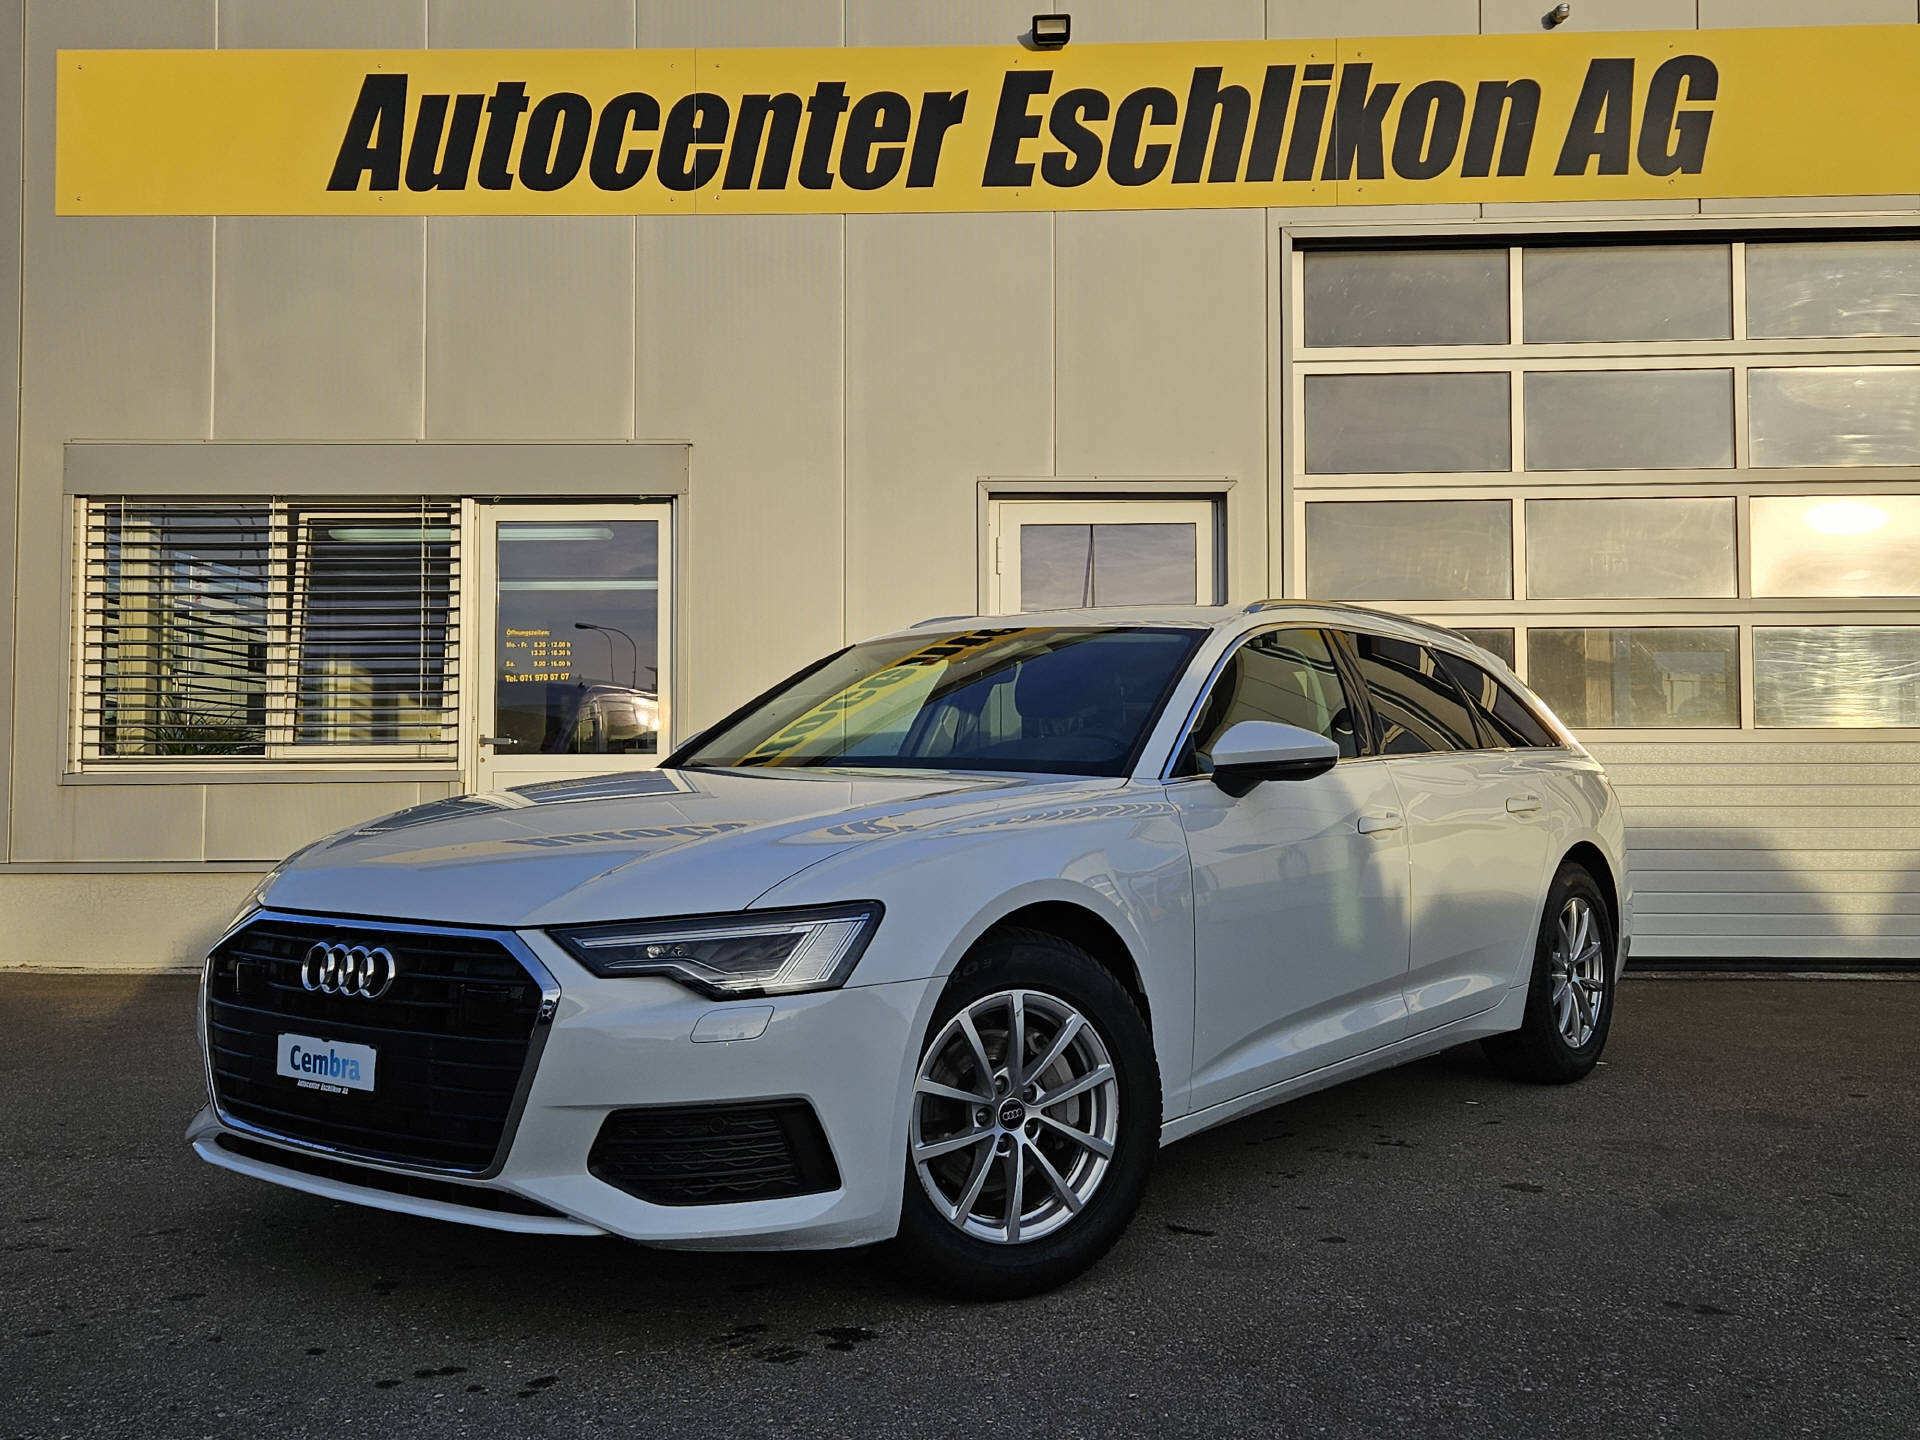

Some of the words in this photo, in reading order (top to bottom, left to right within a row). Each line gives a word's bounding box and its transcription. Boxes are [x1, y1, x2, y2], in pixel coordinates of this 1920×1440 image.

[326, 73, 968, 192] Autocenter
[981, 60, 1541, 188] Eschlikon
[1554, 54, 1720, 176] AG
[505, 674, 518, 682] Tel.
[519, 674, 532, 682] 071
[534, 673, 548, 681] 970
[549, 673, 559, 681] 07
[560, 672, 570, 680] 07
[290, 1044, 361, 1081] Cembra
